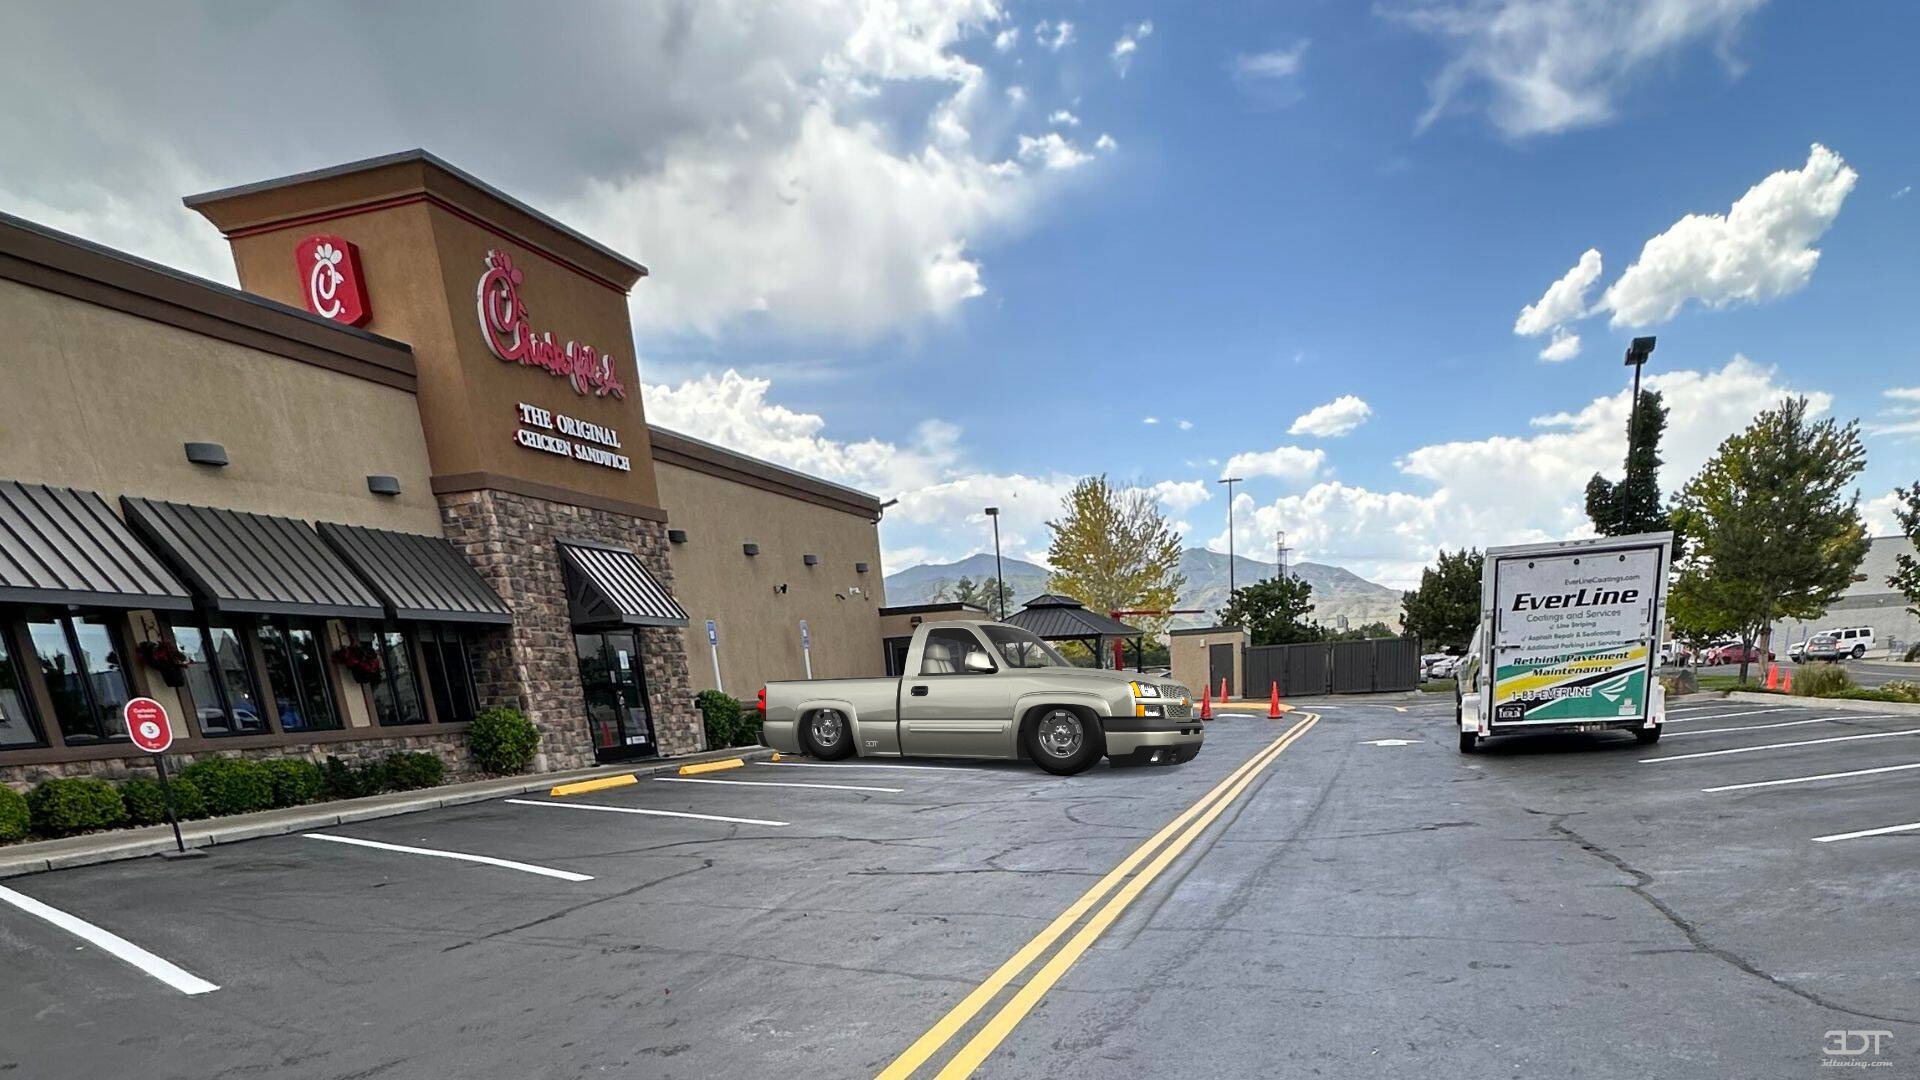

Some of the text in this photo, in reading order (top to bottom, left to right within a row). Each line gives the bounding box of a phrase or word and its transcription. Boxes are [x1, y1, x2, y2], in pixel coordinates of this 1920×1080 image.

[518, 401, 621, 449] THE ORIGINAL
[517, 428, 631, 472] CHICKEN SANDWICH
[1564, 574, 1640, 586] EverLineCoatings.com
[1511, 587, 1639, 612] EverLine
[1526, 609, 1621, 623] Coatings and Services
[1513, 651, 1630, 666] Rethink Pavement
[1532, 665, 1613, 677] Maintenance
[146, 725, 154, 734] 3
